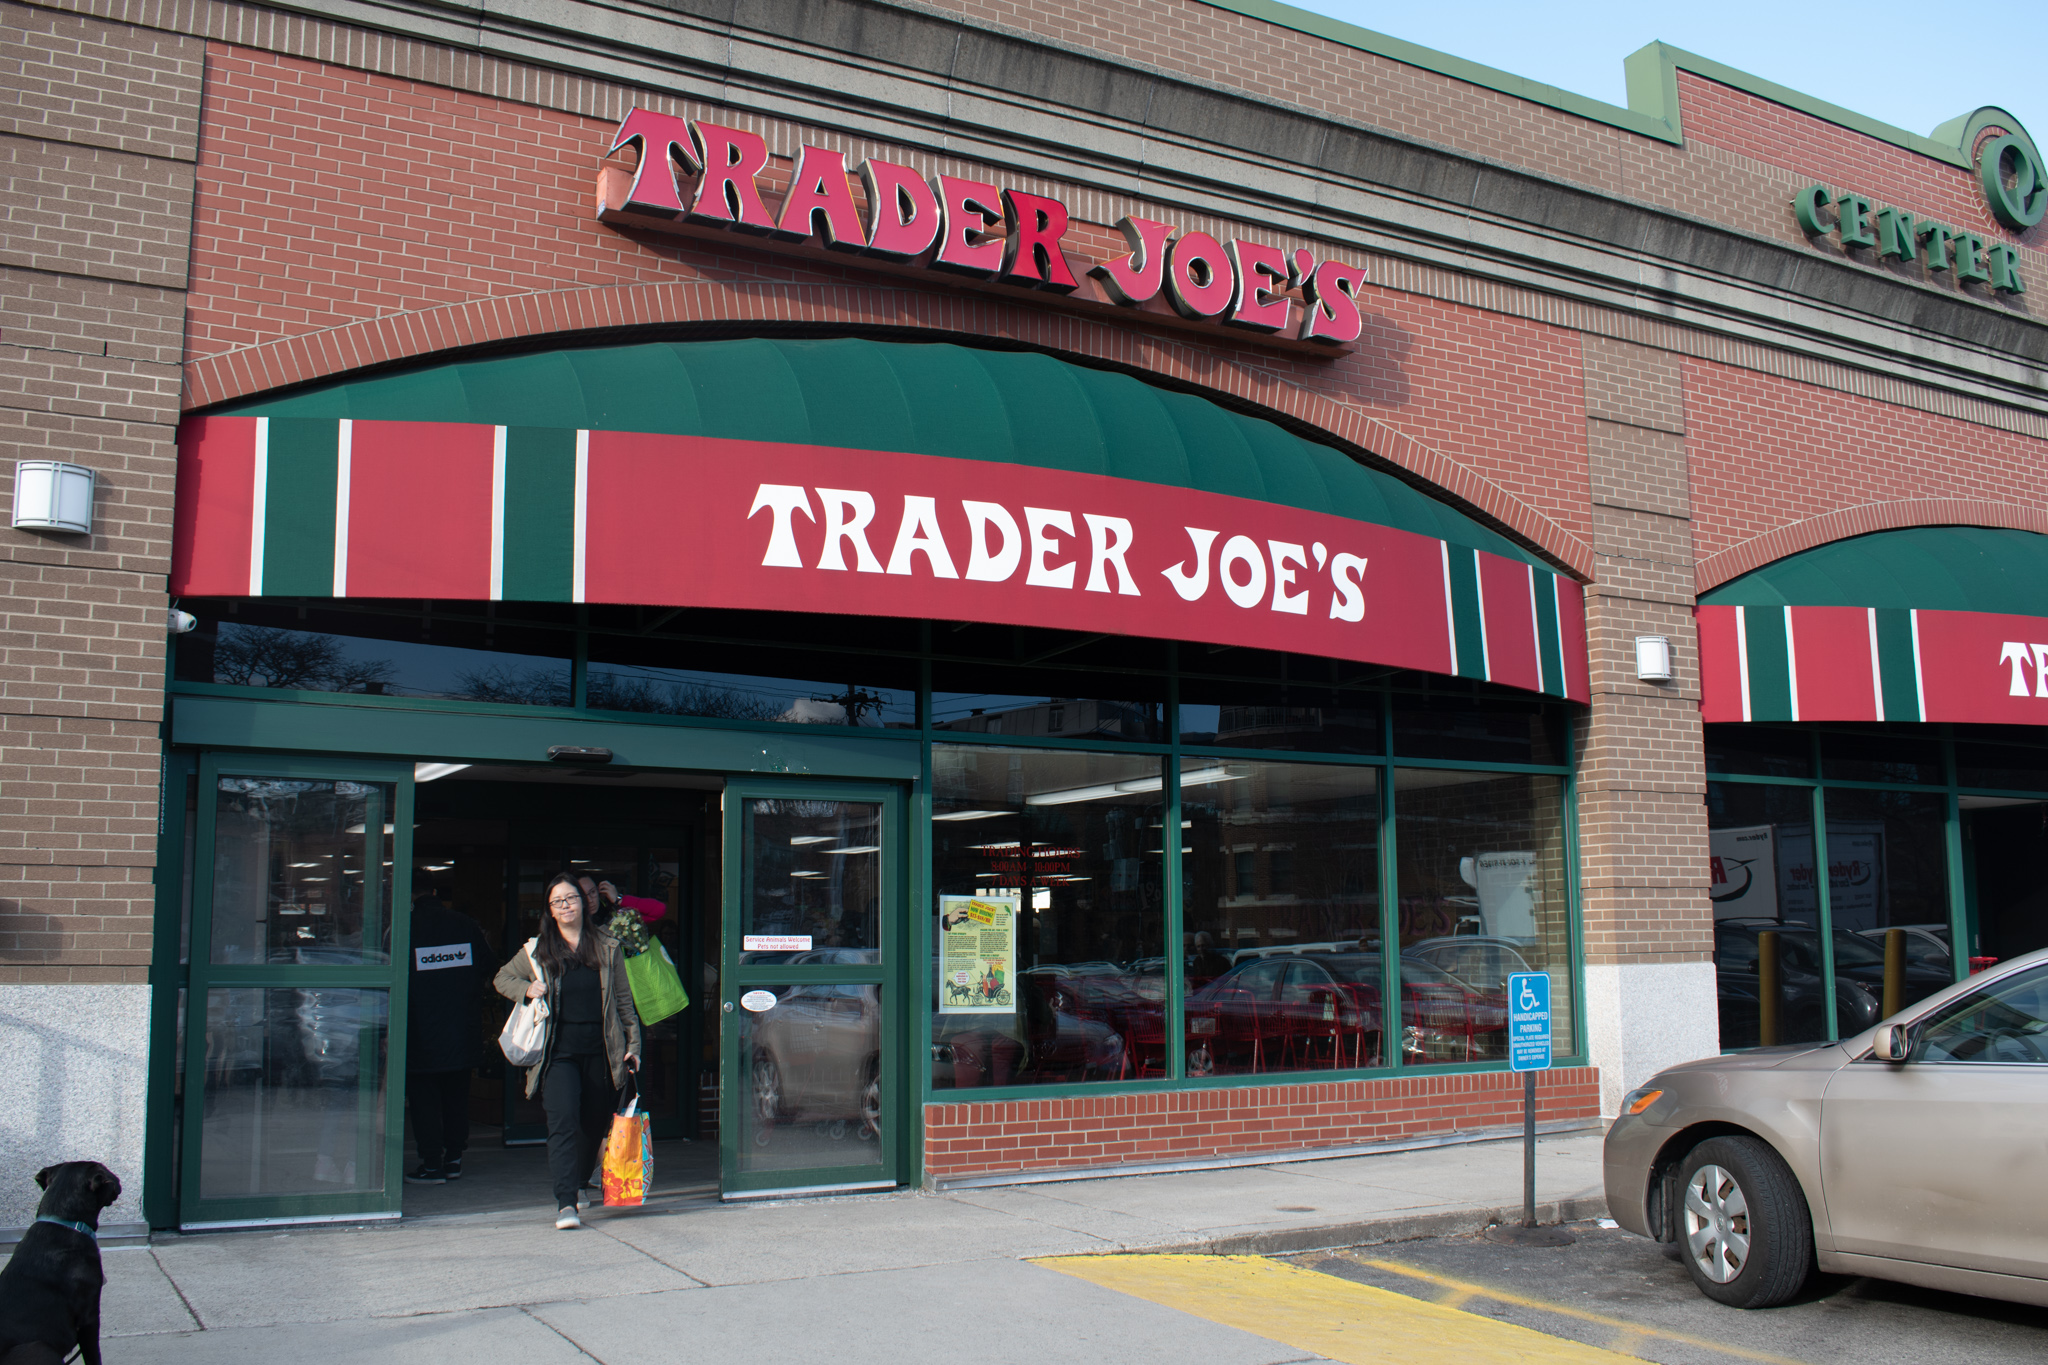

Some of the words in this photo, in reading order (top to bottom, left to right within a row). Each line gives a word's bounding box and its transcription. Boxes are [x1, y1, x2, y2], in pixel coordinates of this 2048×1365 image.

[604, 107, 1079, 295] TRADER
[1086, 213, 1369, 345] JOE'S
[1794, 184, 2026, 296] CENTER
[747, 483, 1142, 597] TRADER
[1161, 525, 1369, 623] JOE'S
[981, 845, 1035, 858] TRADING
[1038, 846, 1081, 859] HOURS
[991, 861, 1027, 872] 8:00AM
[1034, 861, 1070, 873] 10:00PM
[991, 875, 997, 886] 7
[999, 875, 1027, 886] DAYS
[1029, 876, 1037, 887] A
[1039, 876, 1070, 887] WEEK
[421, 953, 455, 964] adidas
[1513, 1012, 1548, 1022] HANDICAPPED
[1520, 1023, 1542, 1033] PARKING
